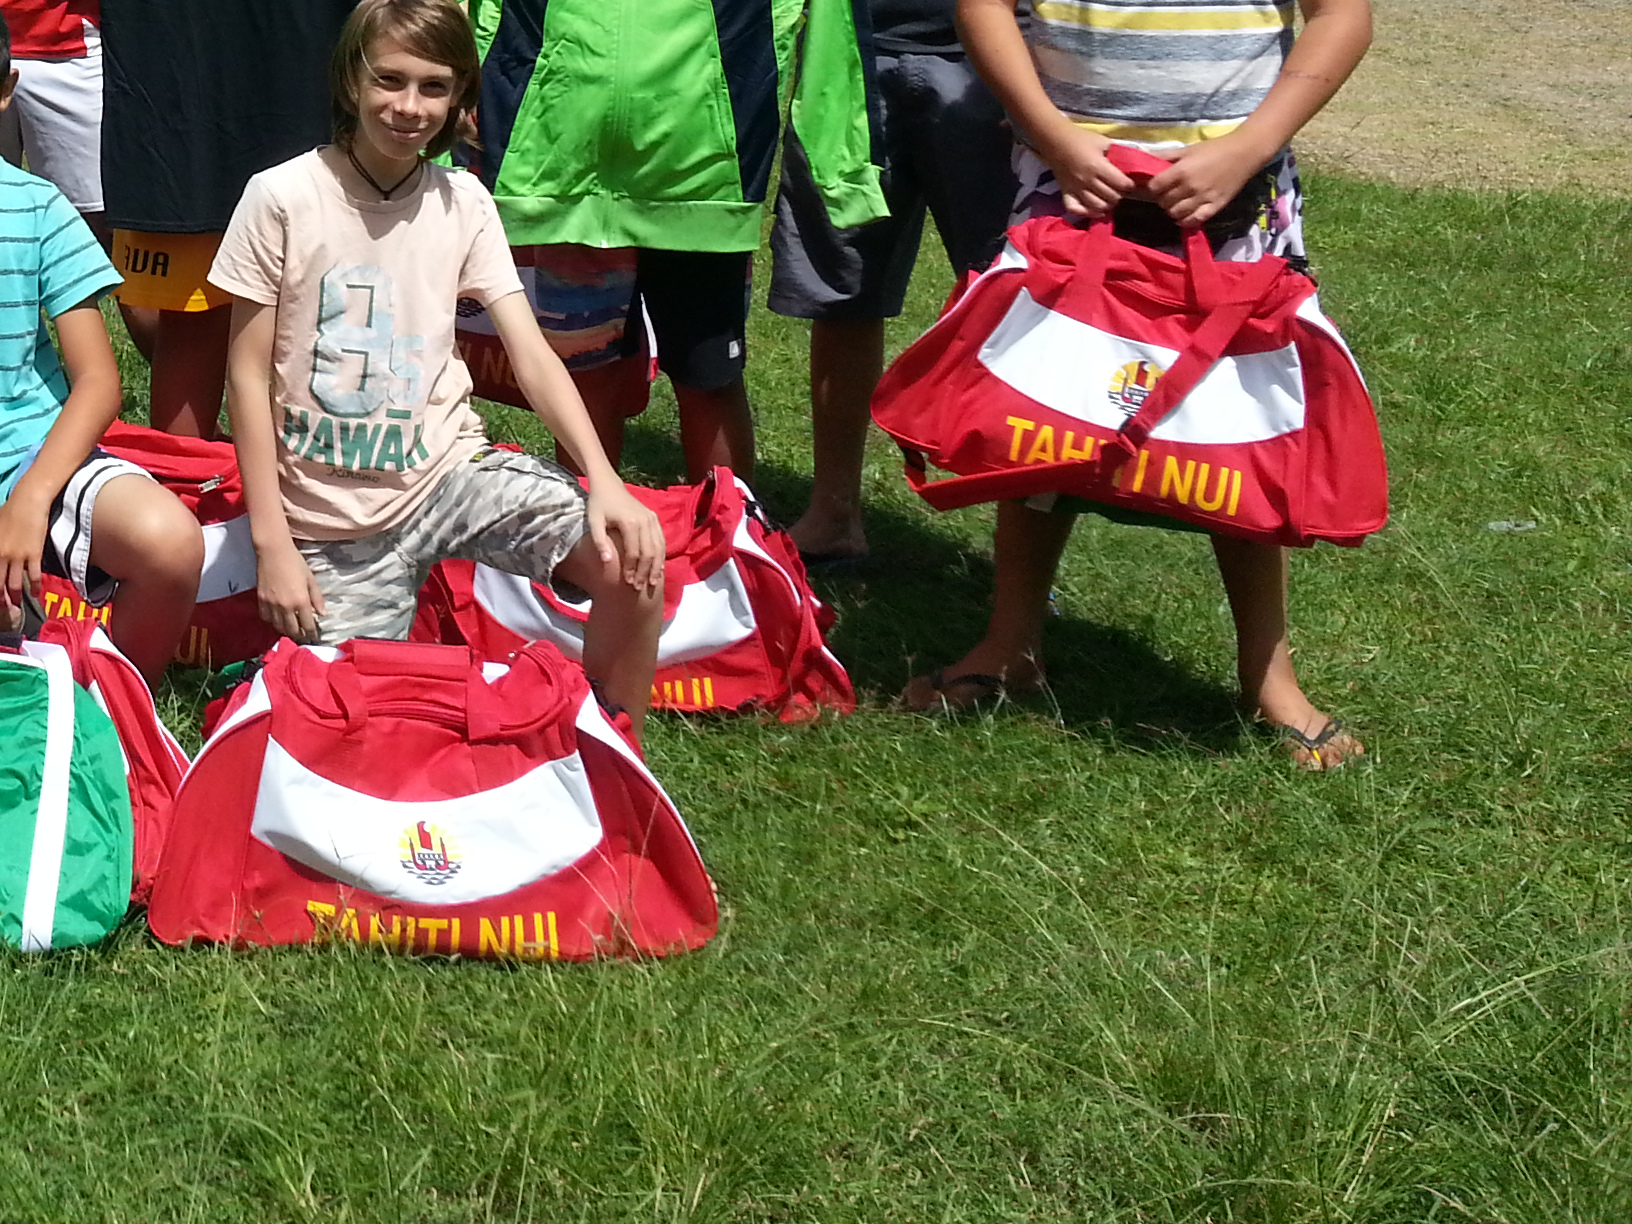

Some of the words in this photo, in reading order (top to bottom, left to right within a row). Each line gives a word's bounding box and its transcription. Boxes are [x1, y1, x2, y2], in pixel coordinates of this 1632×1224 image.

[1006, 415, 1150, 493] TAHI
[1160, 455, 1243, 517] NUI
[306, 900, 461, 954] TAHITI
[479, 911, 560, 959] NUI
